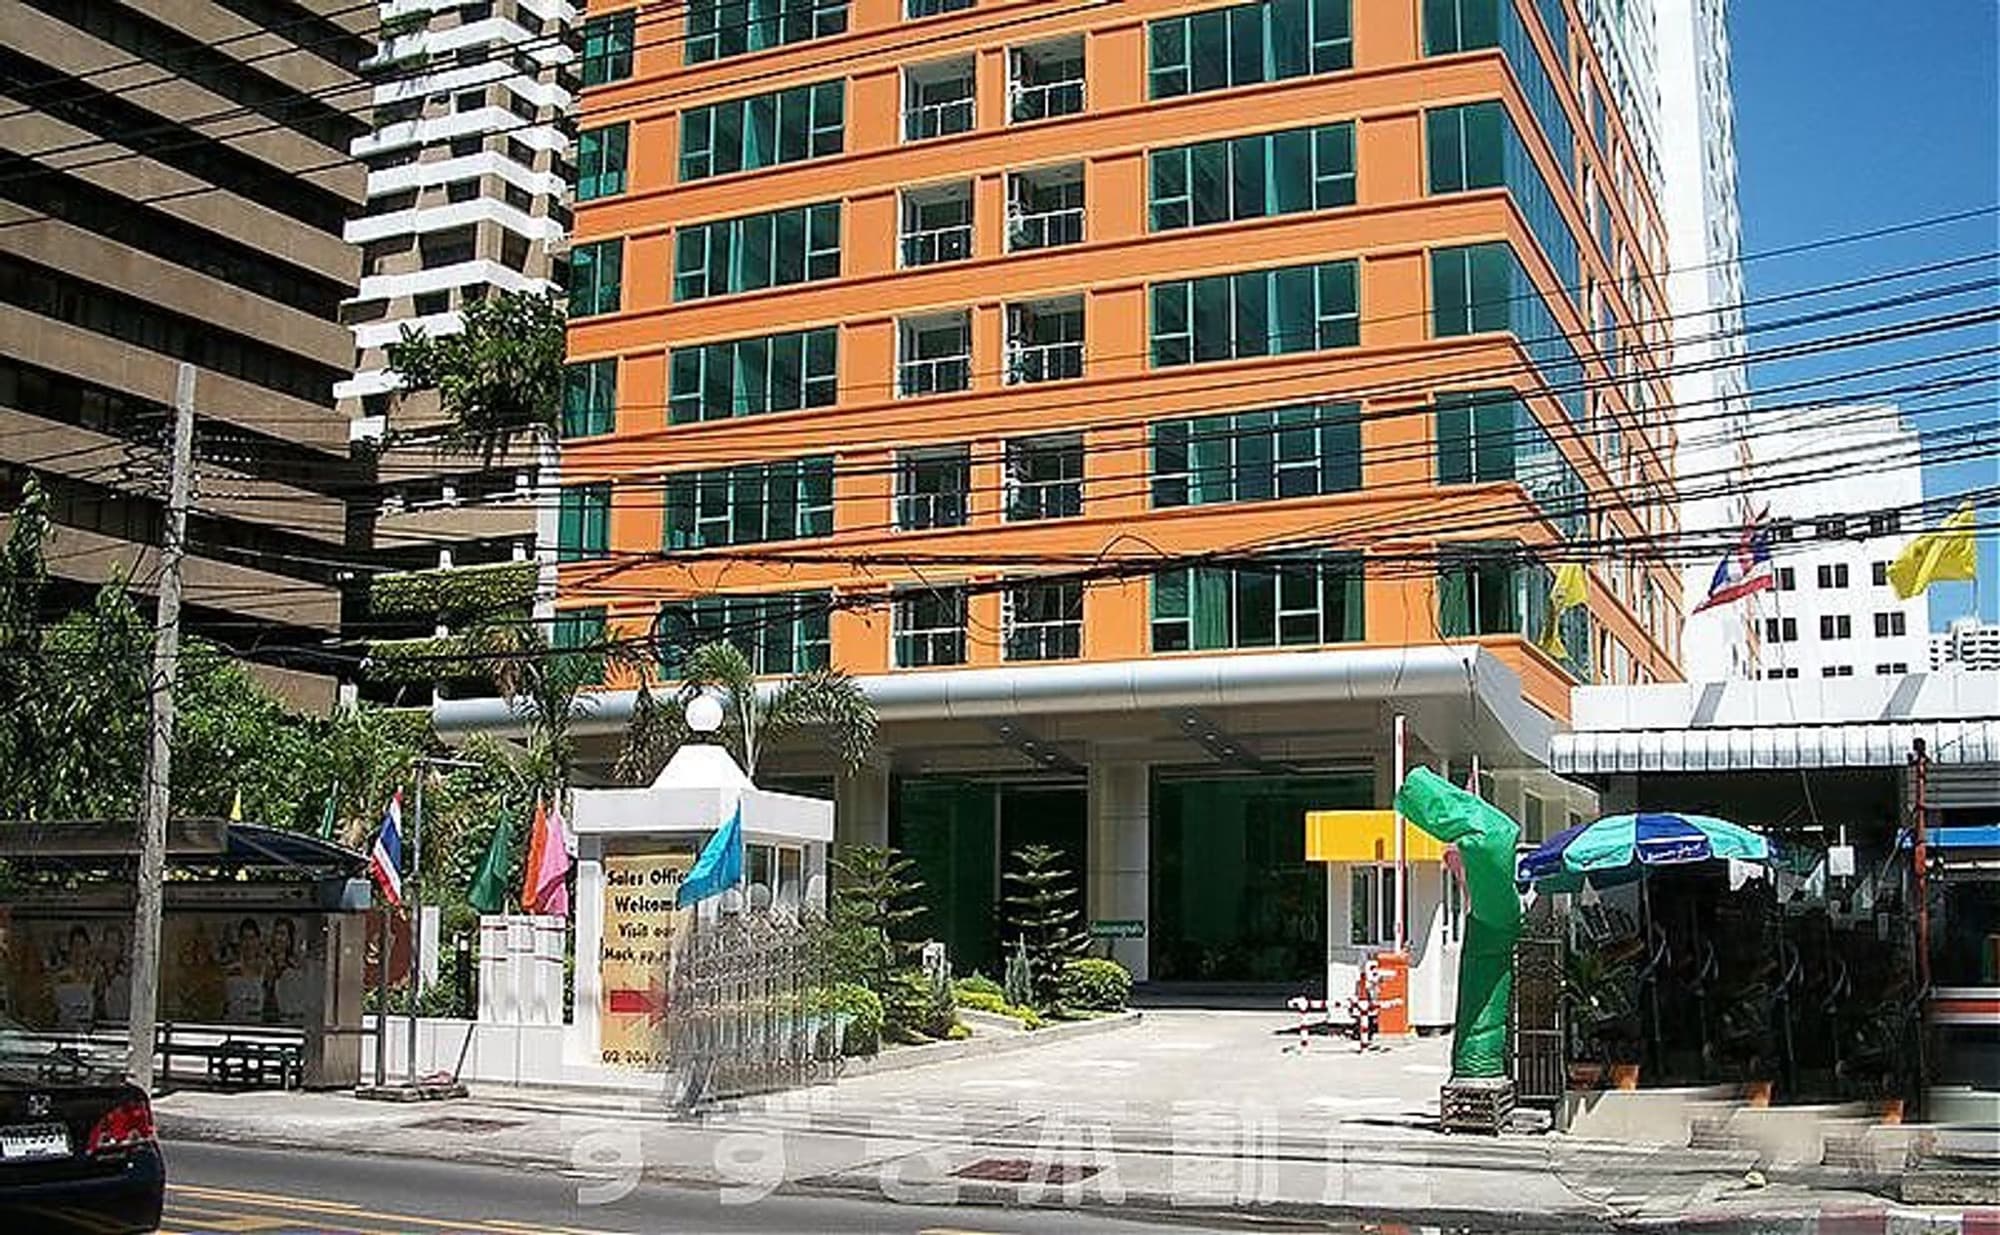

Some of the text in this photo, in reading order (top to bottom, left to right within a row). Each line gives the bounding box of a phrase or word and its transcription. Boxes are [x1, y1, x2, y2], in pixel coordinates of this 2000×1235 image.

[607, 868, 689, 886] Sales Offic
[617, 922, 676, 939] Visit our
